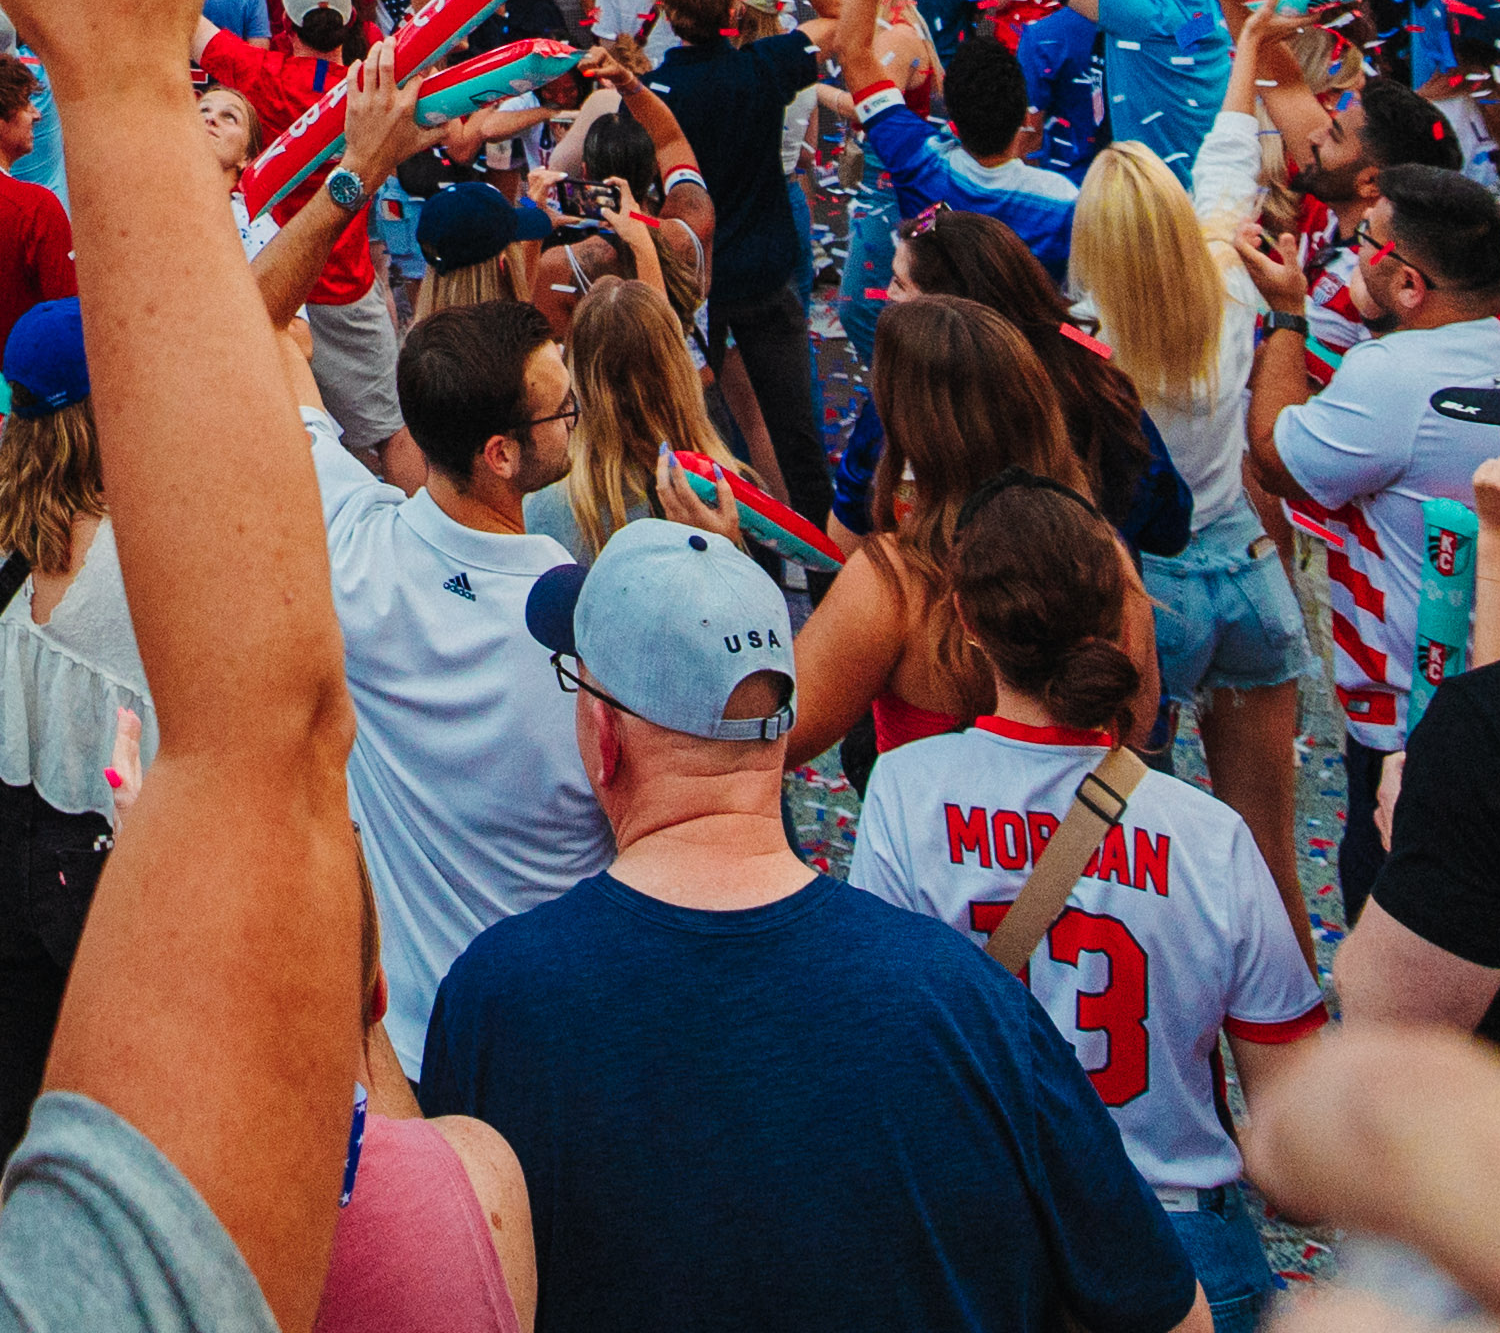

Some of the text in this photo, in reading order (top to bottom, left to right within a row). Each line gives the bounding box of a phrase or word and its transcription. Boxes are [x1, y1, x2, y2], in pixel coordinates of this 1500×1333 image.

[253, 78, 349, 178] ABY
[1440, 398, 1482, 416] BLK
[1433, 528, 1456, 575] KC
[723, 626, 783, 656] USA
[1422, 640, 1446, 685] KC
